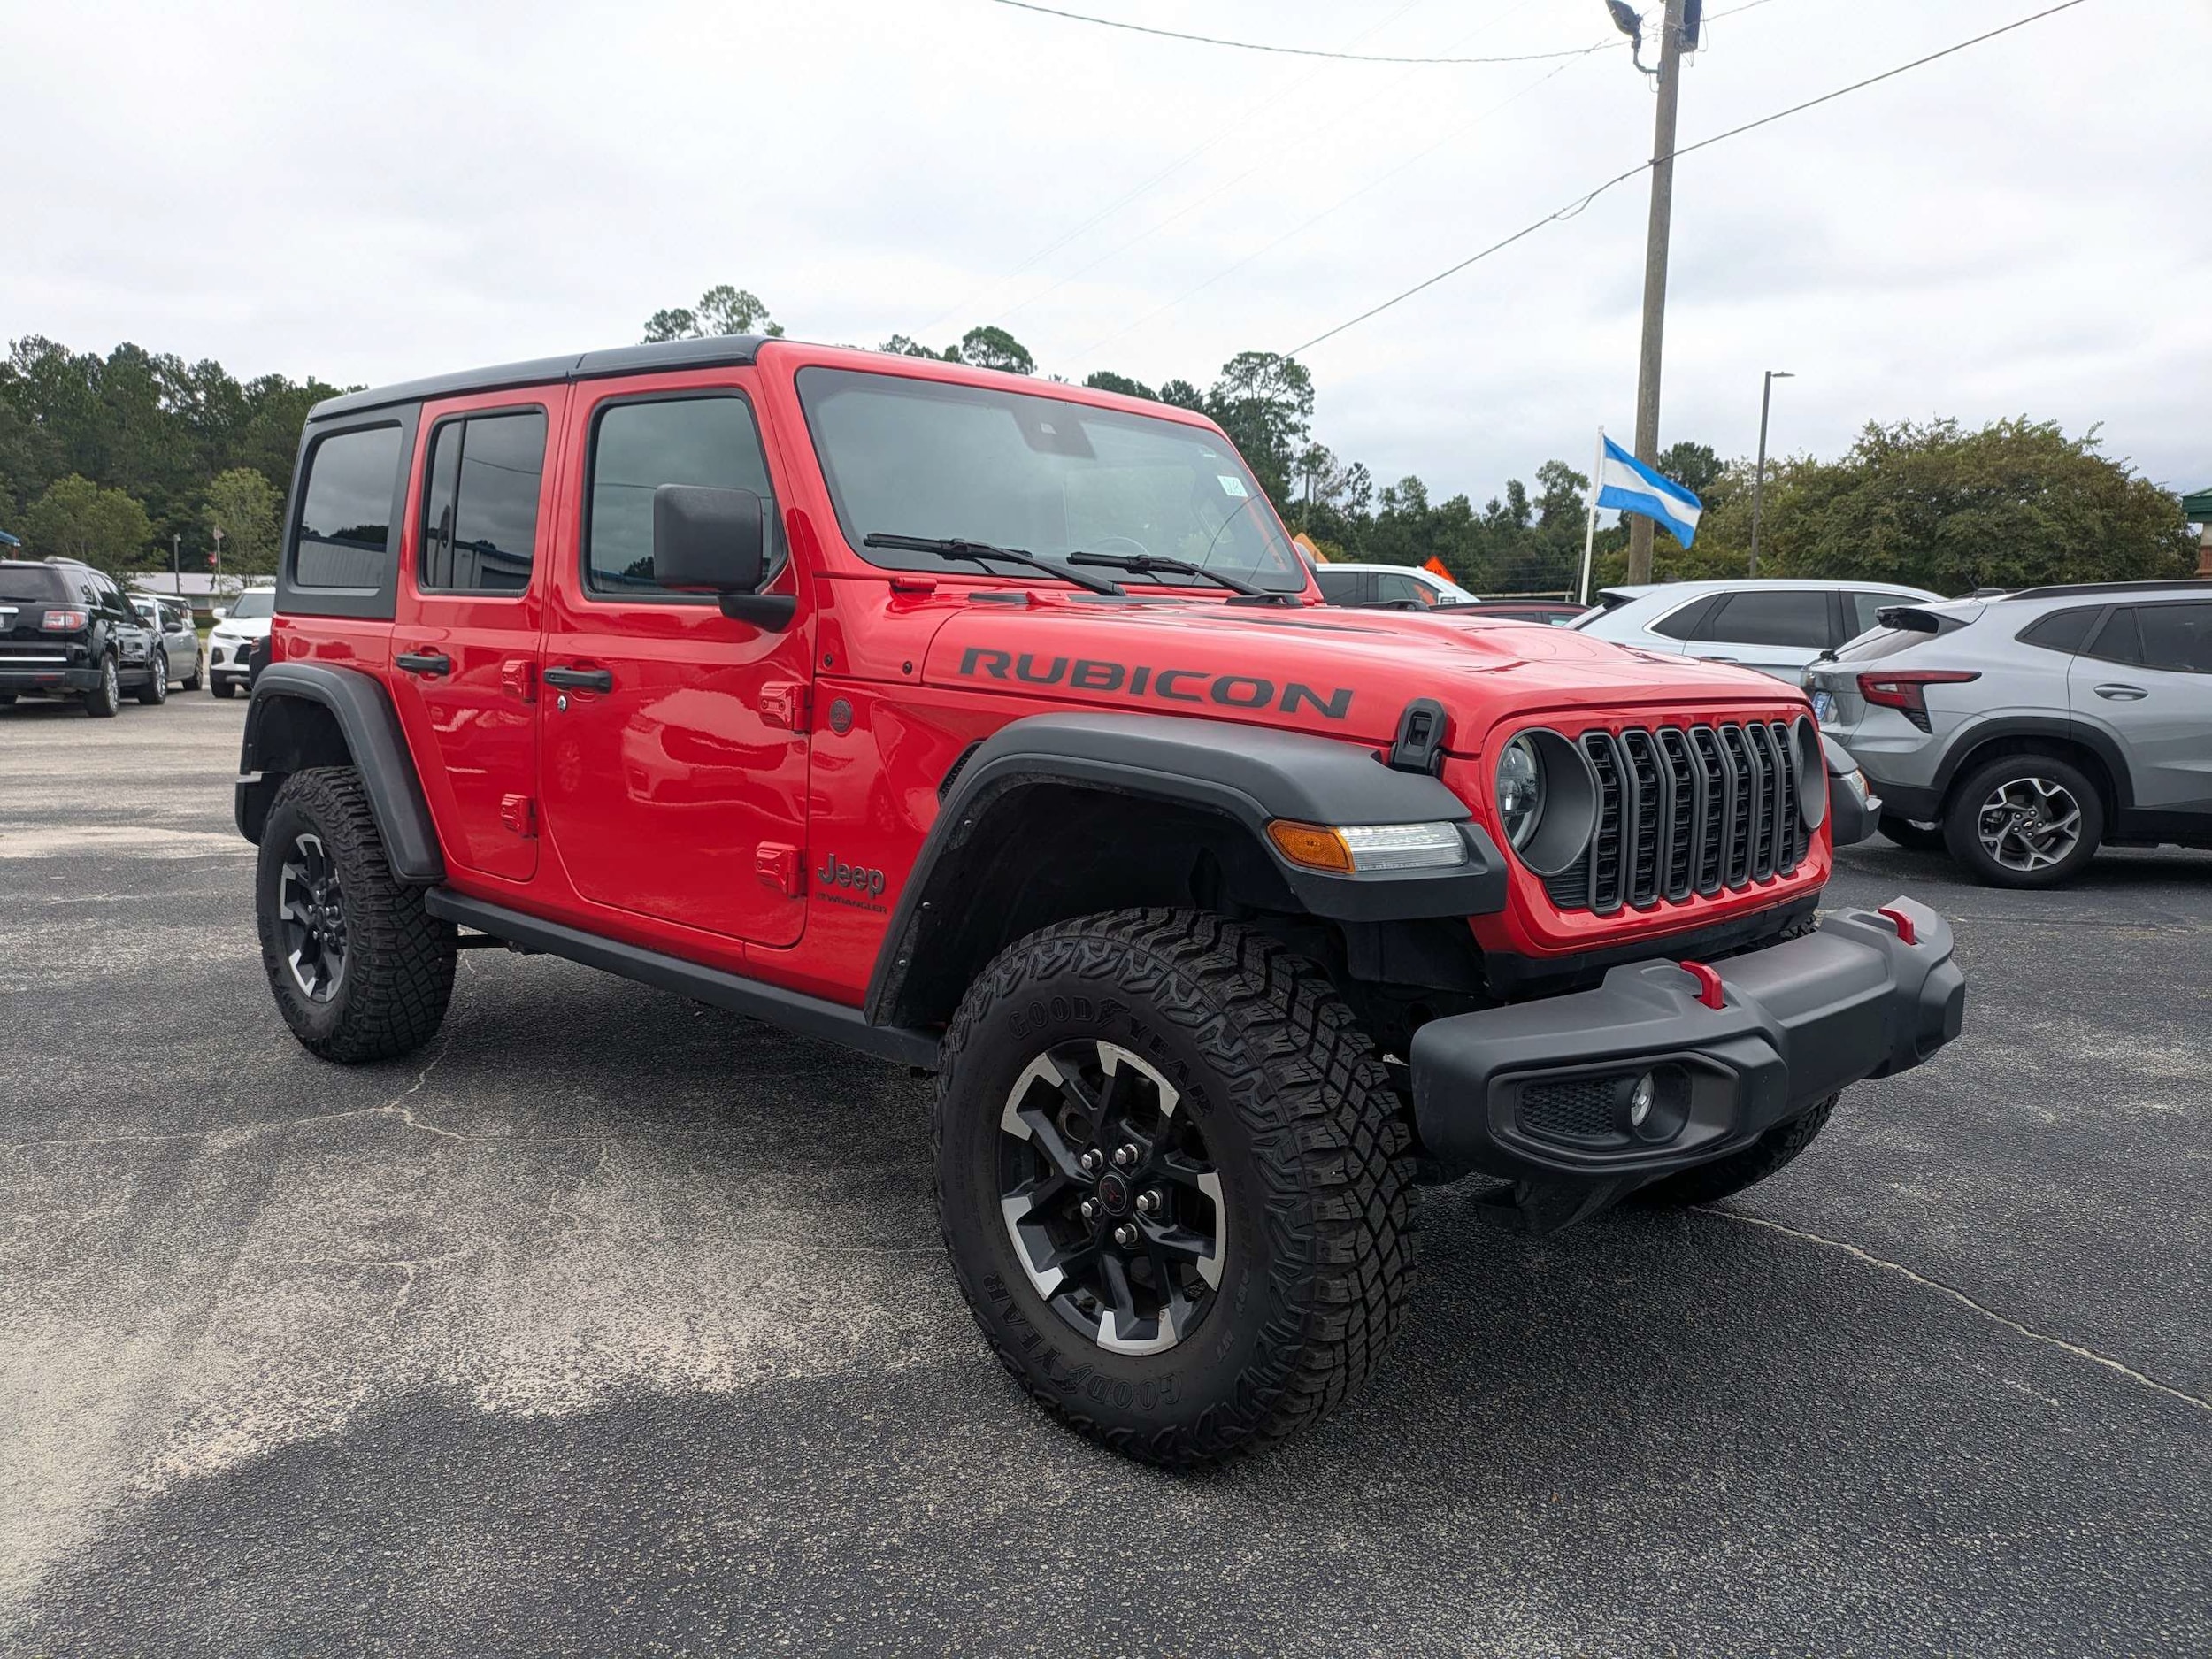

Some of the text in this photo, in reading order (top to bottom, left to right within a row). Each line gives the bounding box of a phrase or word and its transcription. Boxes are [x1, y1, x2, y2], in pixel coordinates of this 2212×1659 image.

[959, 647, 1354, 720] RUBICON
[818, 853, 885, 900] Jeep
[826, 893, 887, 913] WRANGLER
